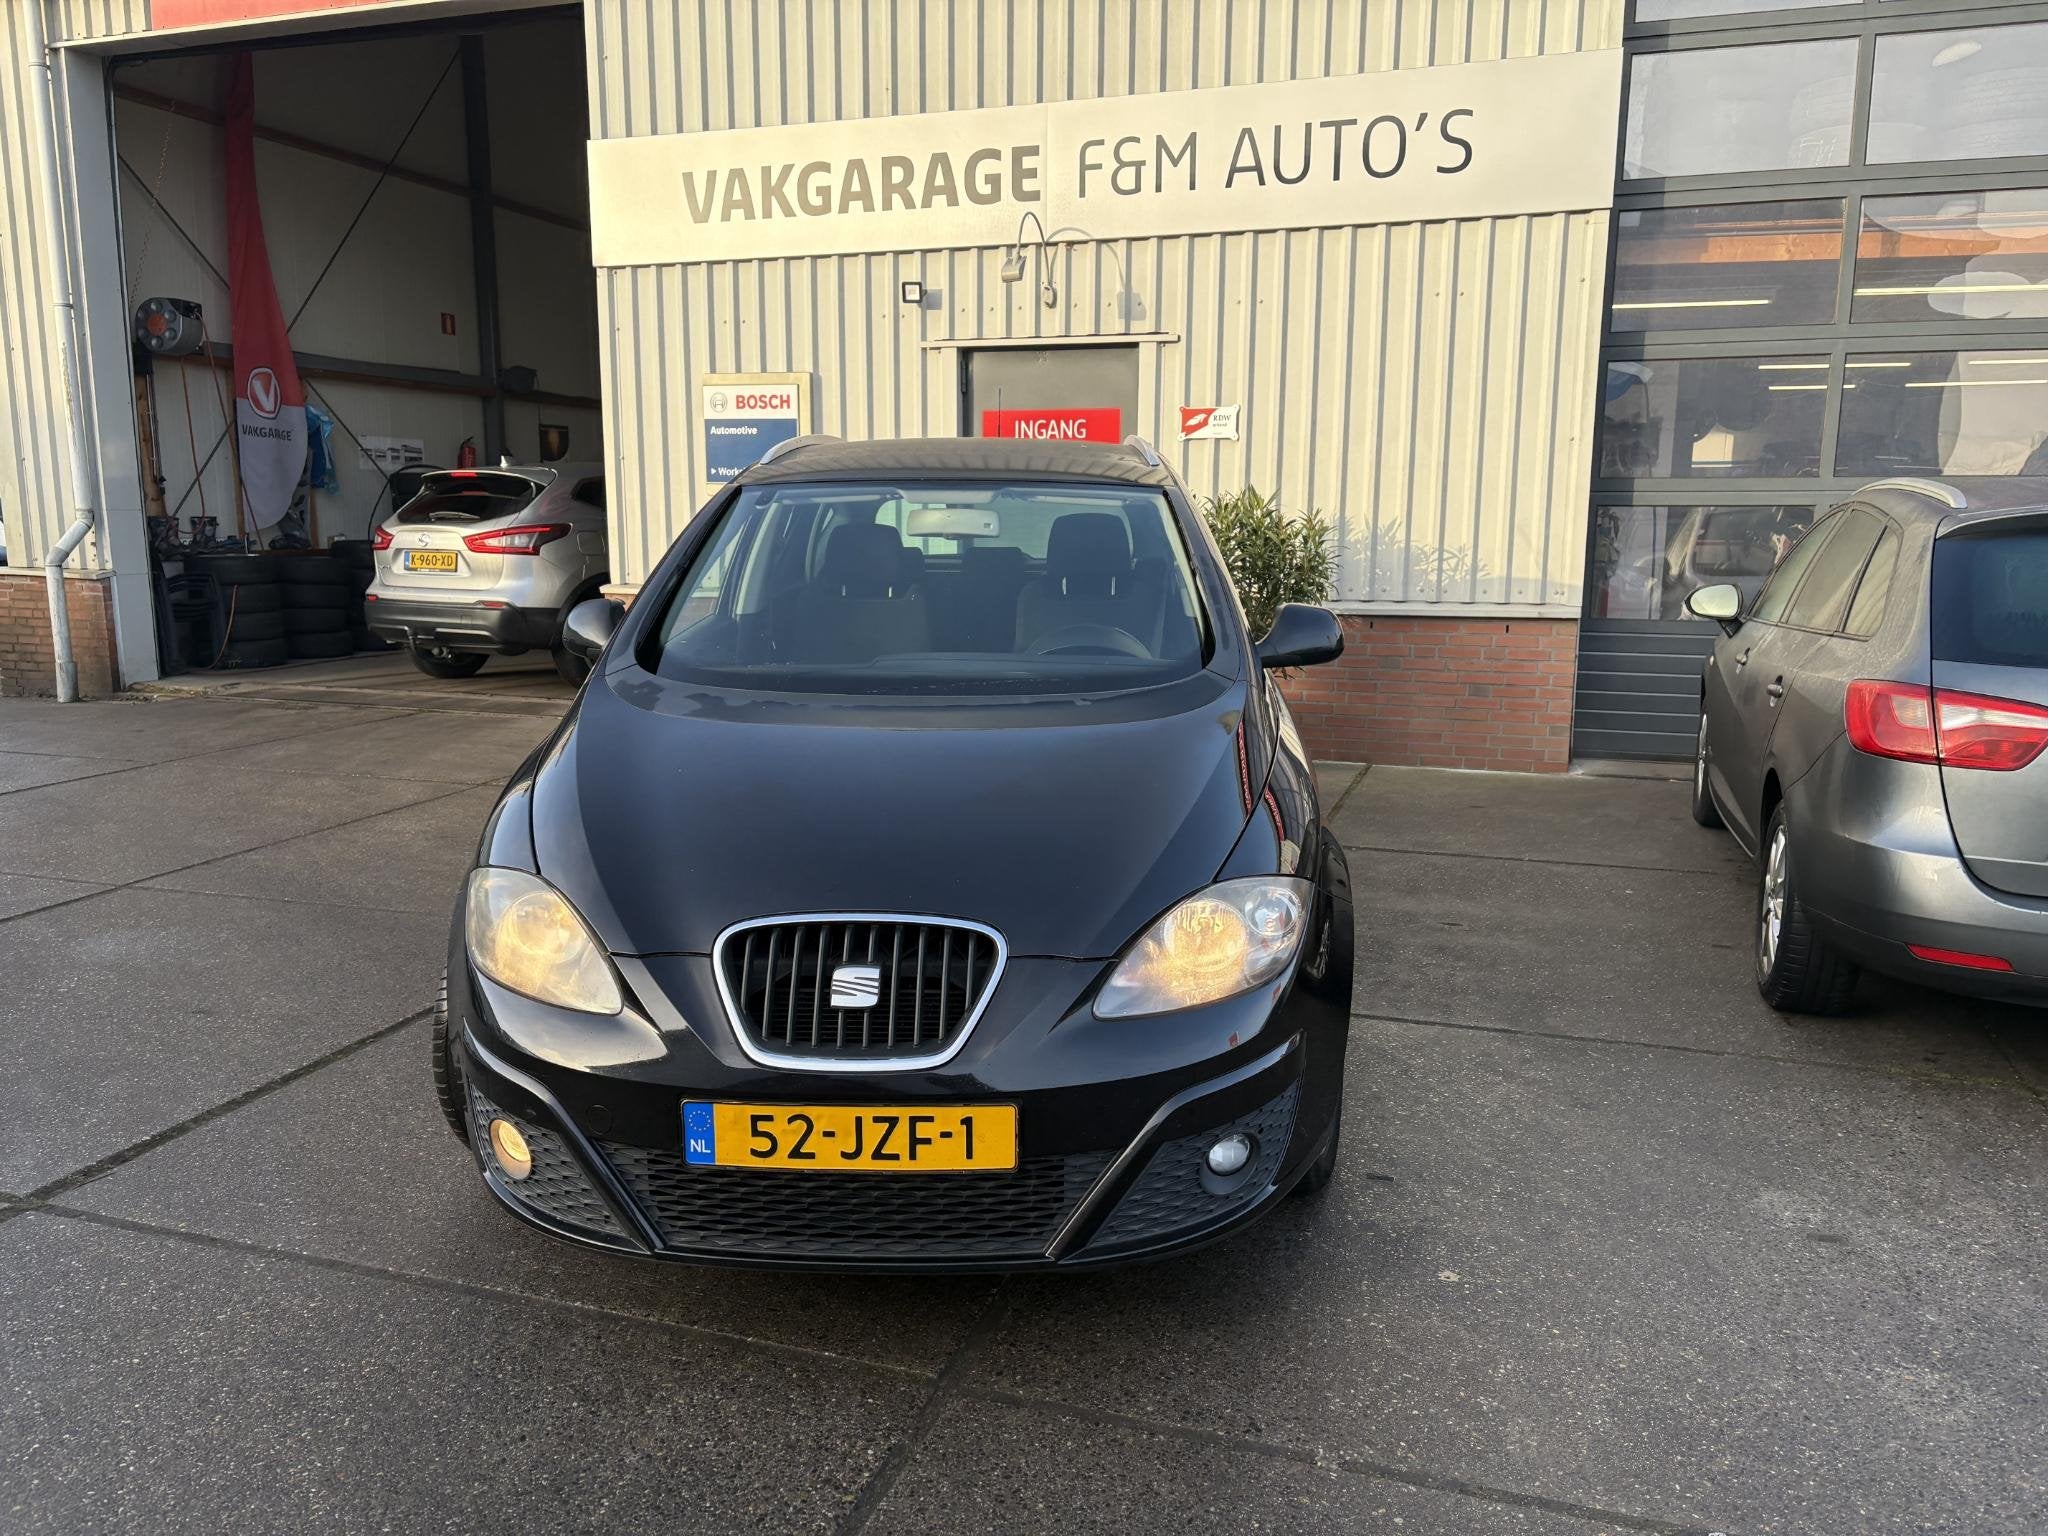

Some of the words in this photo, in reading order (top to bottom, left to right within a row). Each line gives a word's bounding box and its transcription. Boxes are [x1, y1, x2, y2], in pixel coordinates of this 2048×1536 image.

[682, 145, 1041, 224] VAKGARAGE
[1078, 131, 1197, 198] F&M
[1225, 108, 1474, 188] AUTO'S
[735, 394, 791, 410] BOSCH
[710, 426, 758, 435] Automotive
[1015, 419, 1087, 439] INGANG
[718, 466, 746, 476] Work
[411, 554, 453, 567] K-960-XD
[750, 1113, 974, 1161] 52-JZF-1
[690, 1138, 711, 1153] NL
